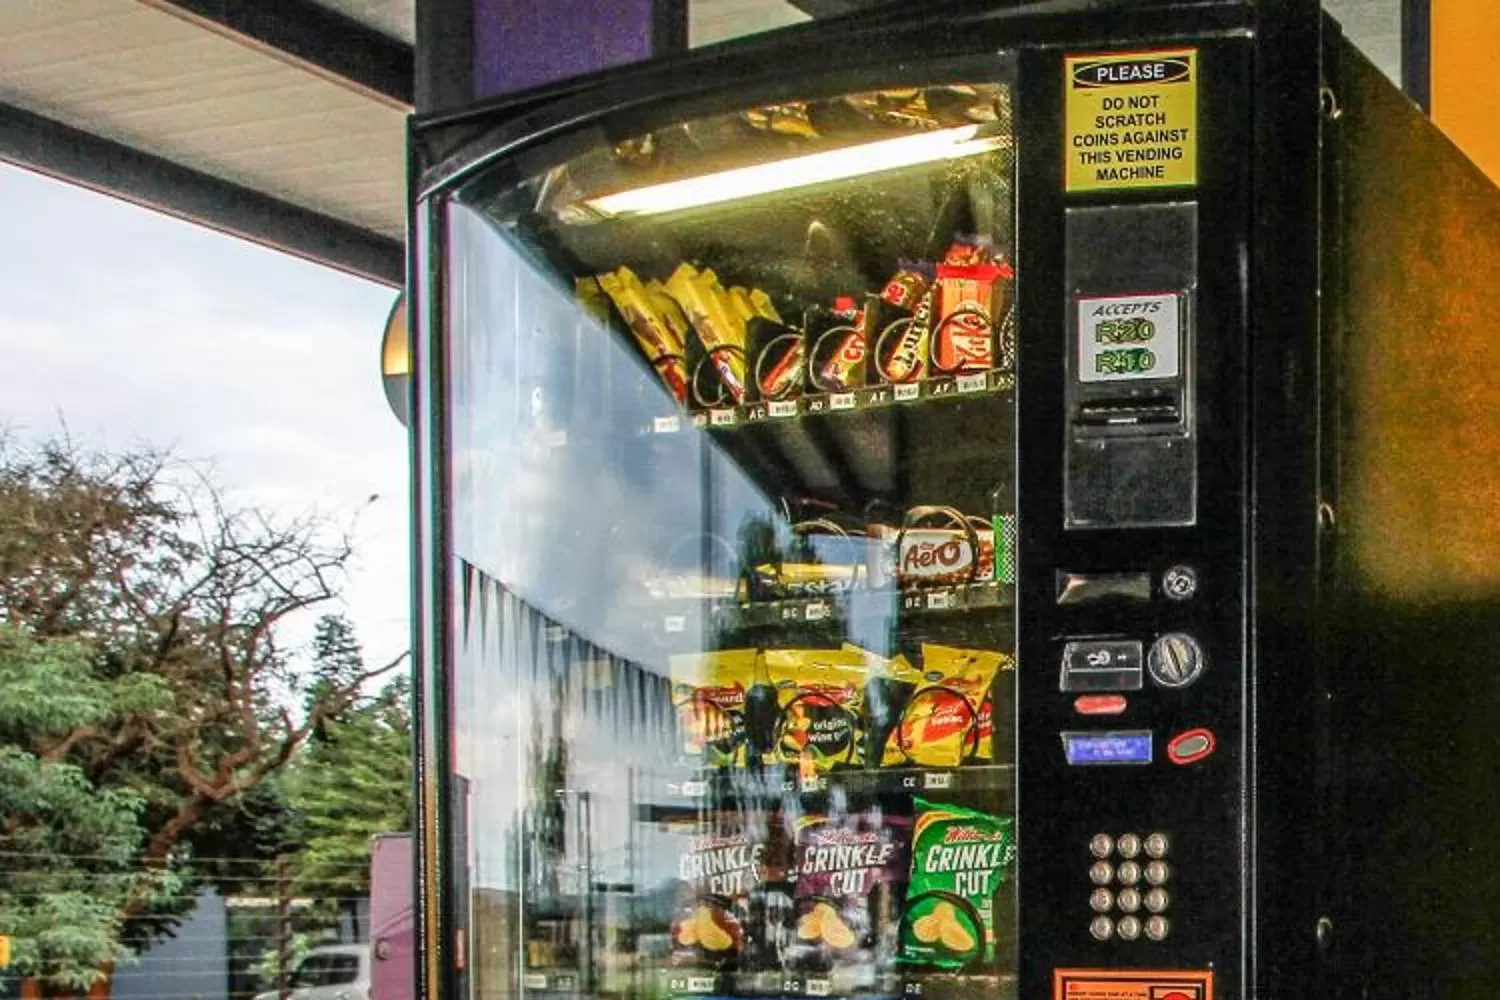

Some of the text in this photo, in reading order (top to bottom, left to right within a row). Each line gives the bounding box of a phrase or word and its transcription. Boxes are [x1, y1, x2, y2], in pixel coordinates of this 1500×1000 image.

[1097, 63, 1165, 81] PLEASE
[1103, 95, 1159, 111] DO NOT
[1095, 113, 1166, 129] SCRATCH
[1073, 128, 1188, 147] COINS AGAINST
[1079, 147, 1182, 164] THIS VENDING
[1096, 165, 1165, 181] MACHINE
[1092, 301, 1163, 316] ACCEPTS
[803, 844, 894, 874] CRINKLE
[926, 845, 1015, 873] CRINKLE
[711, 871, 743, 896] CUT
[830, 869, 867, 896] CUT
[954, 870, 993, 897] CUT
